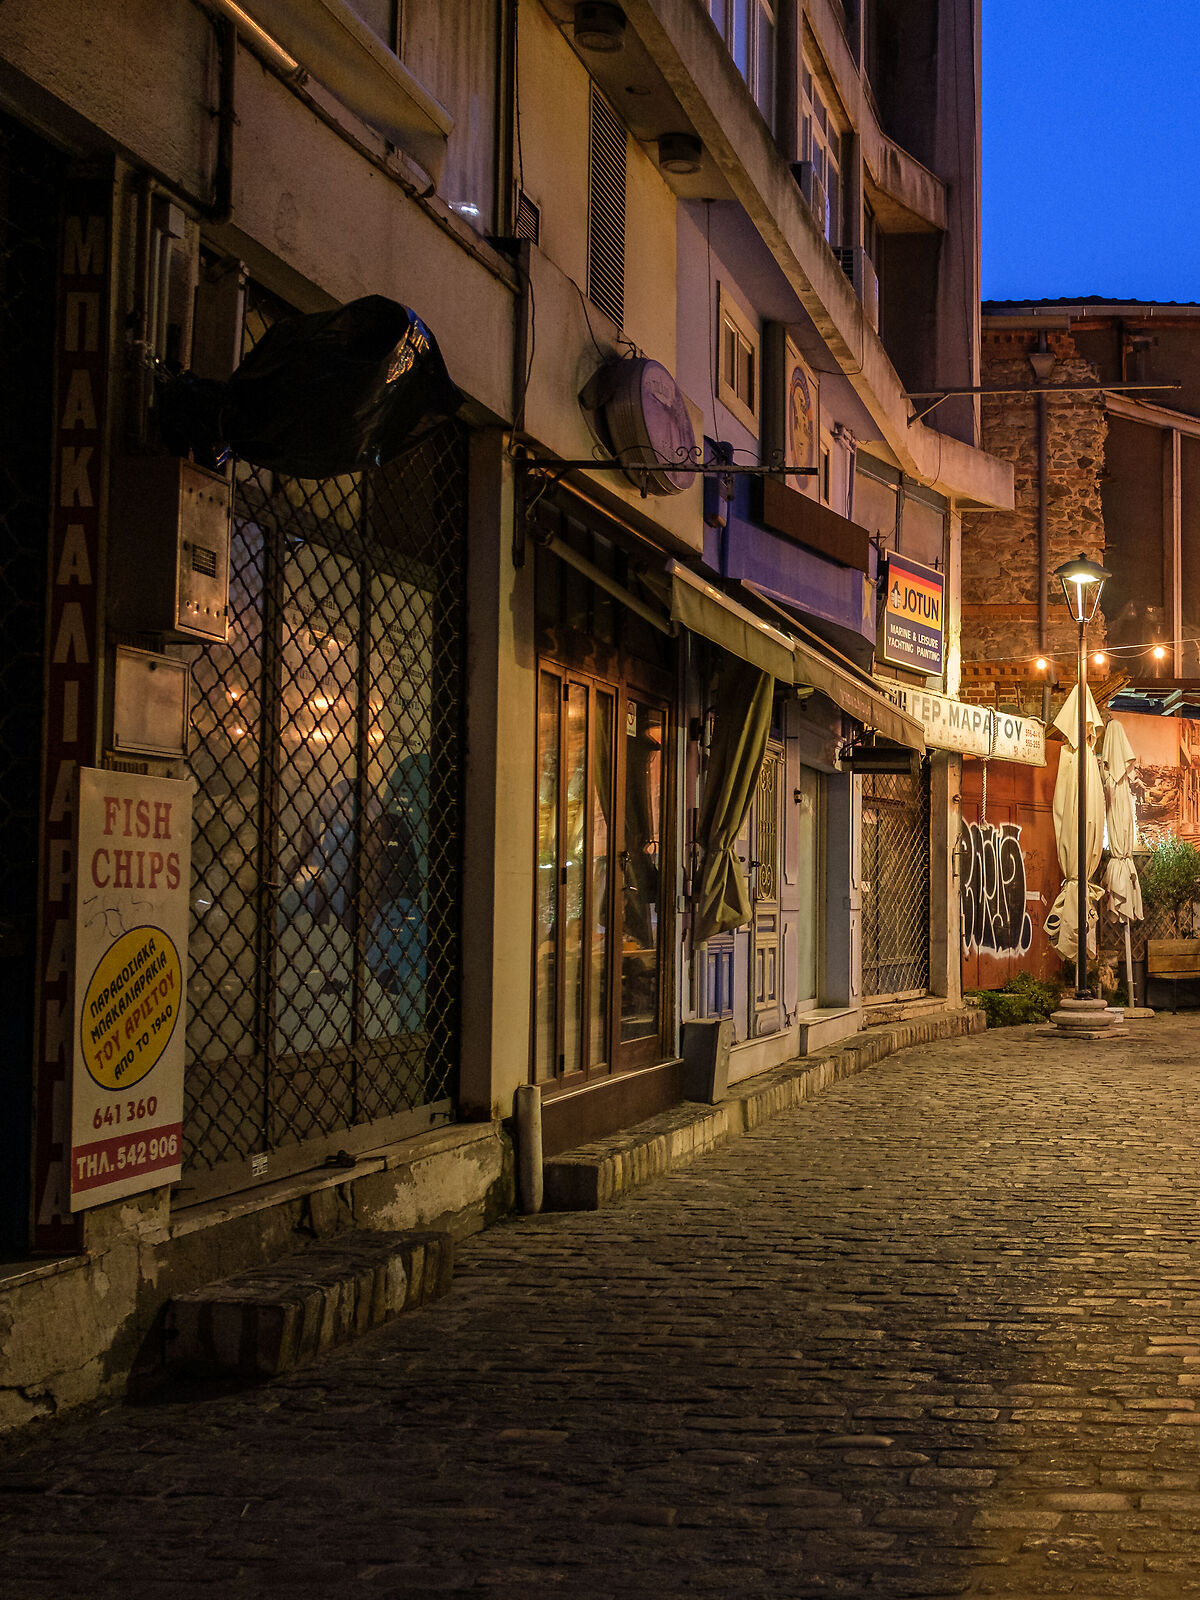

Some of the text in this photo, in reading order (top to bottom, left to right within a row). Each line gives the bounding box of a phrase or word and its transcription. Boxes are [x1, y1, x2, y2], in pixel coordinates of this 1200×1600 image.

[902, 586, 939, 622] JOTUN
[887, 635, 941, 662] YACHTING PAINTING
[890, 623, 939, 650] MARINE & LEISURE
[103, 796, 172, 840] FISH
[91, 847, 181, 890] CHIPS
[90, 937, 156, 1018] ΠΑΡΑΔΟΣΙΑΚΑ
[90, 950, 168, 1045] ΜΠΑΚΑΛΙΑΡΑΚΙΑ
[94, 968, 175, 1070] ΤΟΥ ΑΡΙΣΤΟΥ
[114, 1004, 173, 1081] ΑΠΟ ΤΟ 1940
[93, 1096, 158, 1129] 641 360
